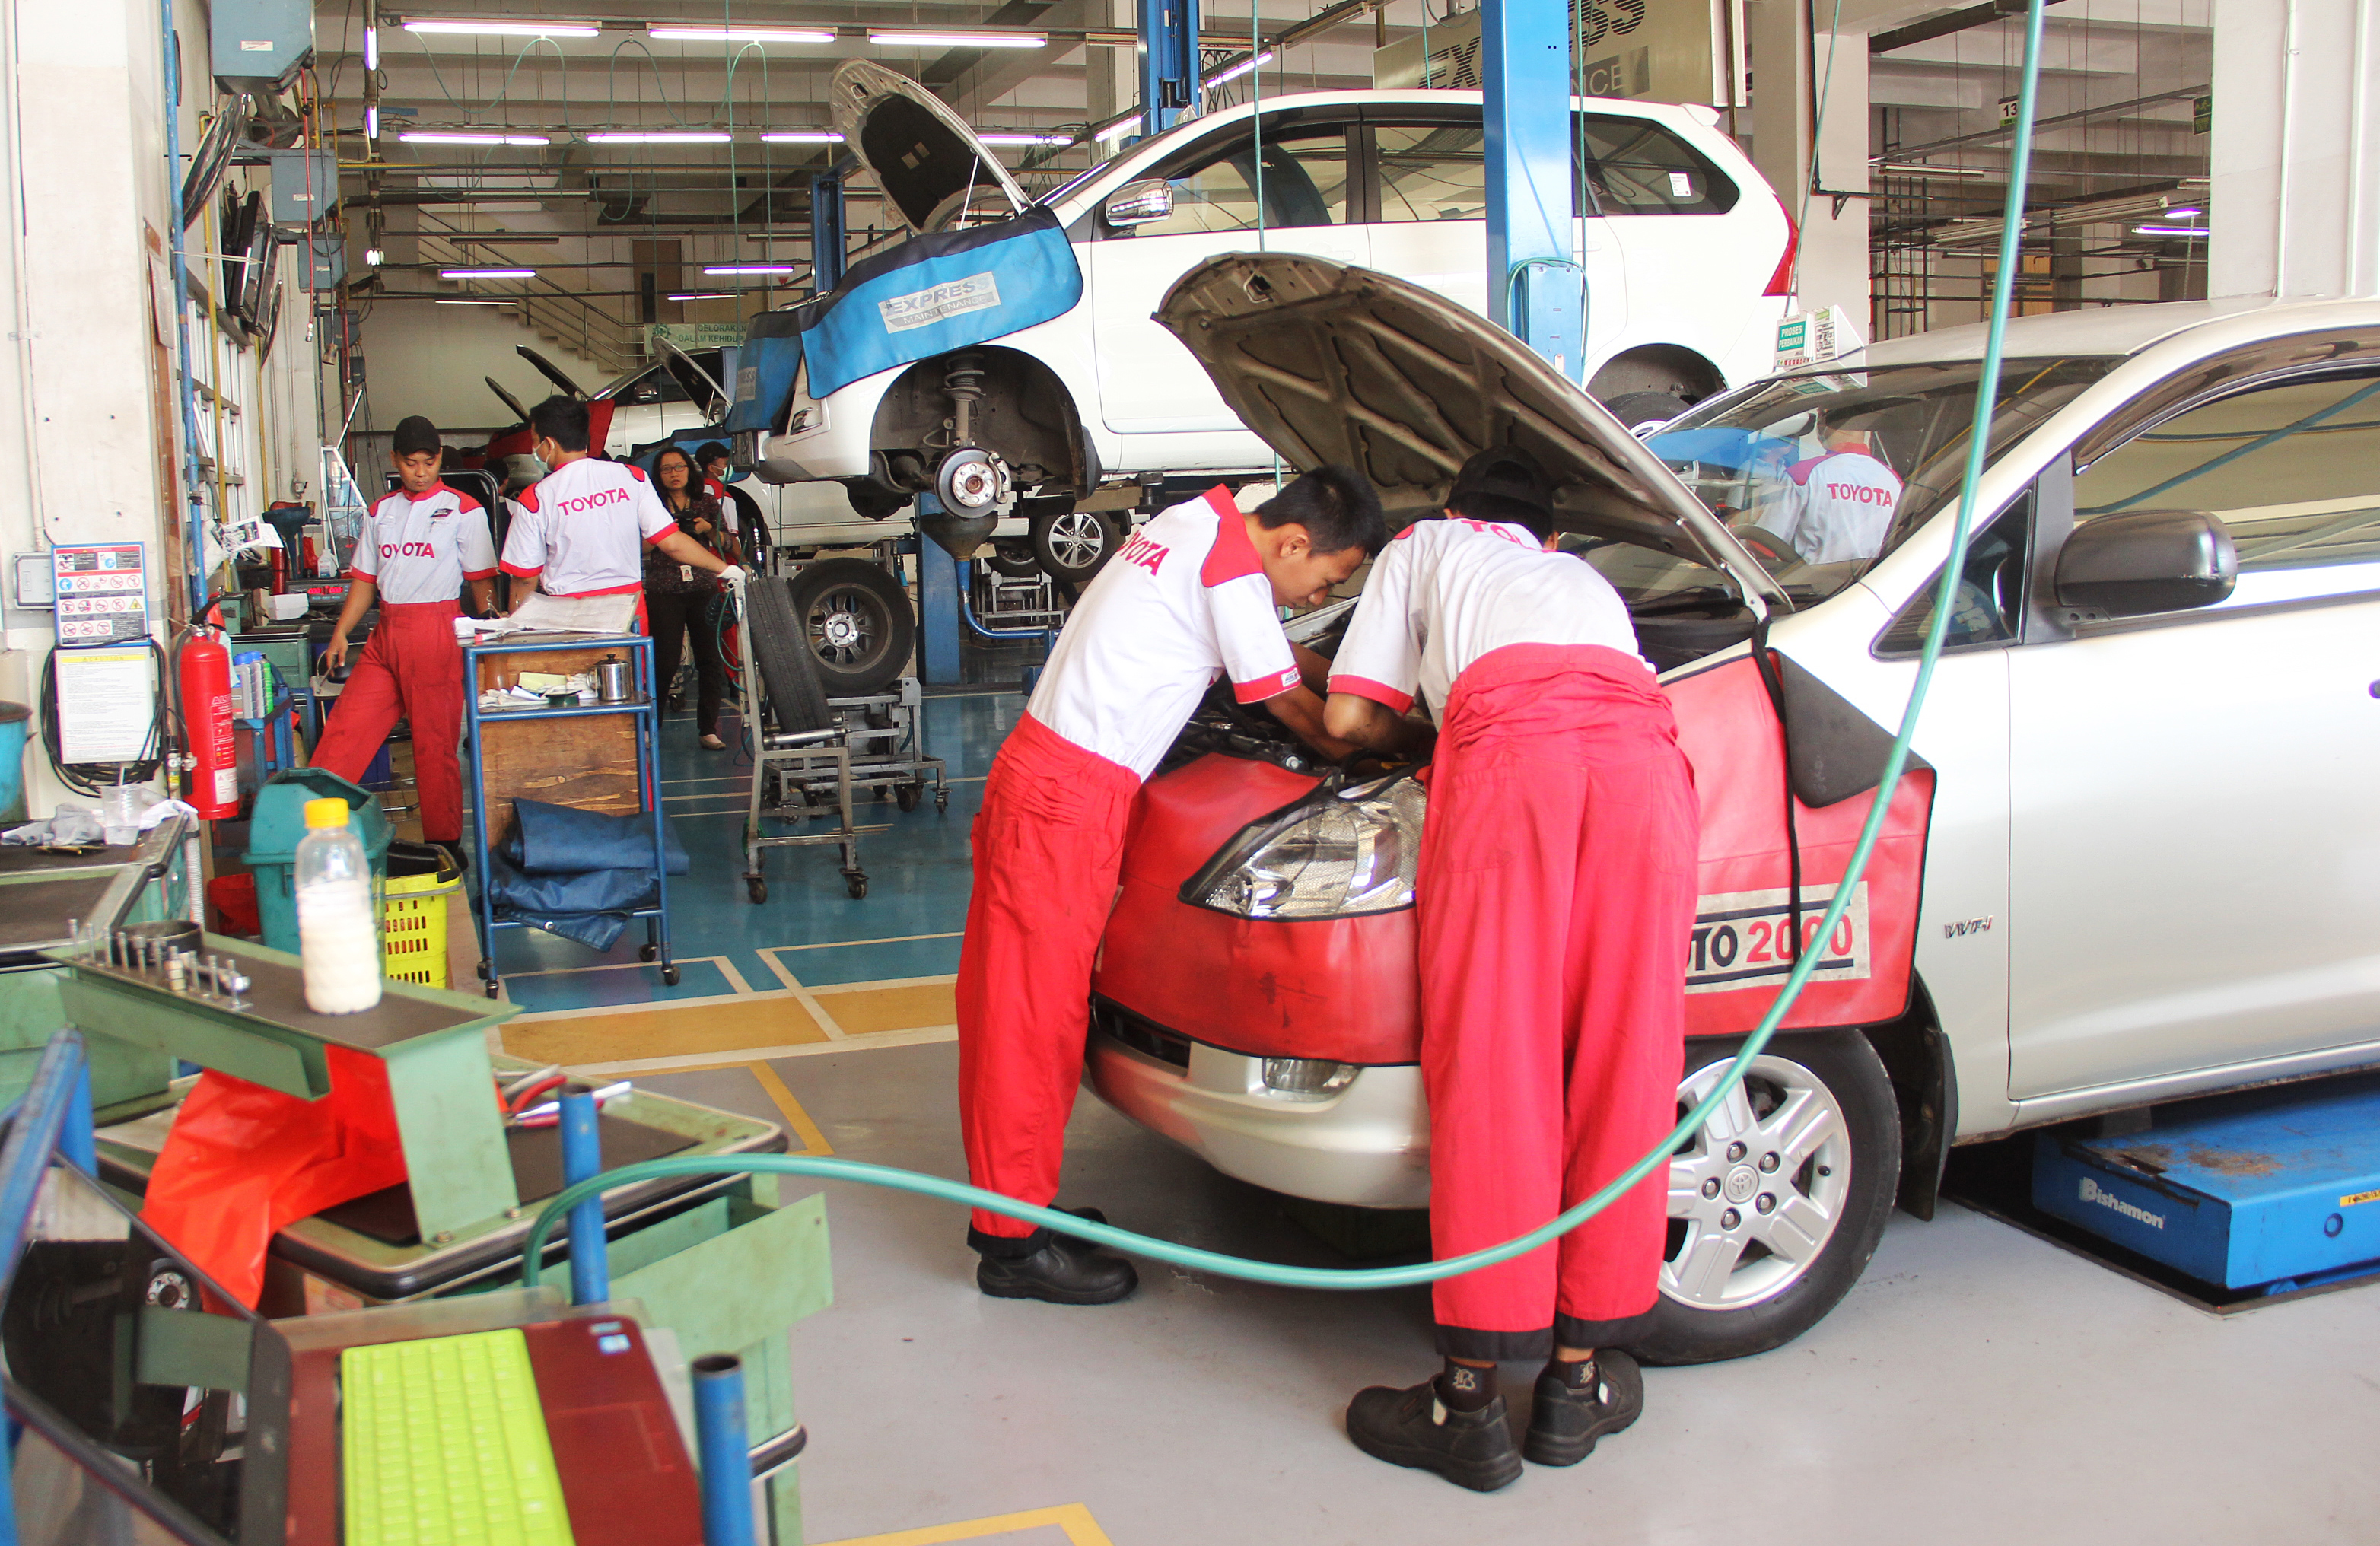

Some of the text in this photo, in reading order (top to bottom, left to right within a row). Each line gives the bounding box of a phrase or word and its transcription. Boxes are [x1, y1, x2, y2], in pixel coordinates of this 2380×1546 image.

[2003, 103, 2018, 117] 13
[886, 277, 991, 317] EXPRESS
[904, 295, 988, 324] MAINTENANCE
[708, 335, 746, 343] KEHIDUP
[557, 488, 630, 516] TOYOTA
[1827, 483, 1892, 507] TOYOTA
[378, 542, 435, 558] OYOTA
[2079, 1176, 2165, 1229] Bishamon
